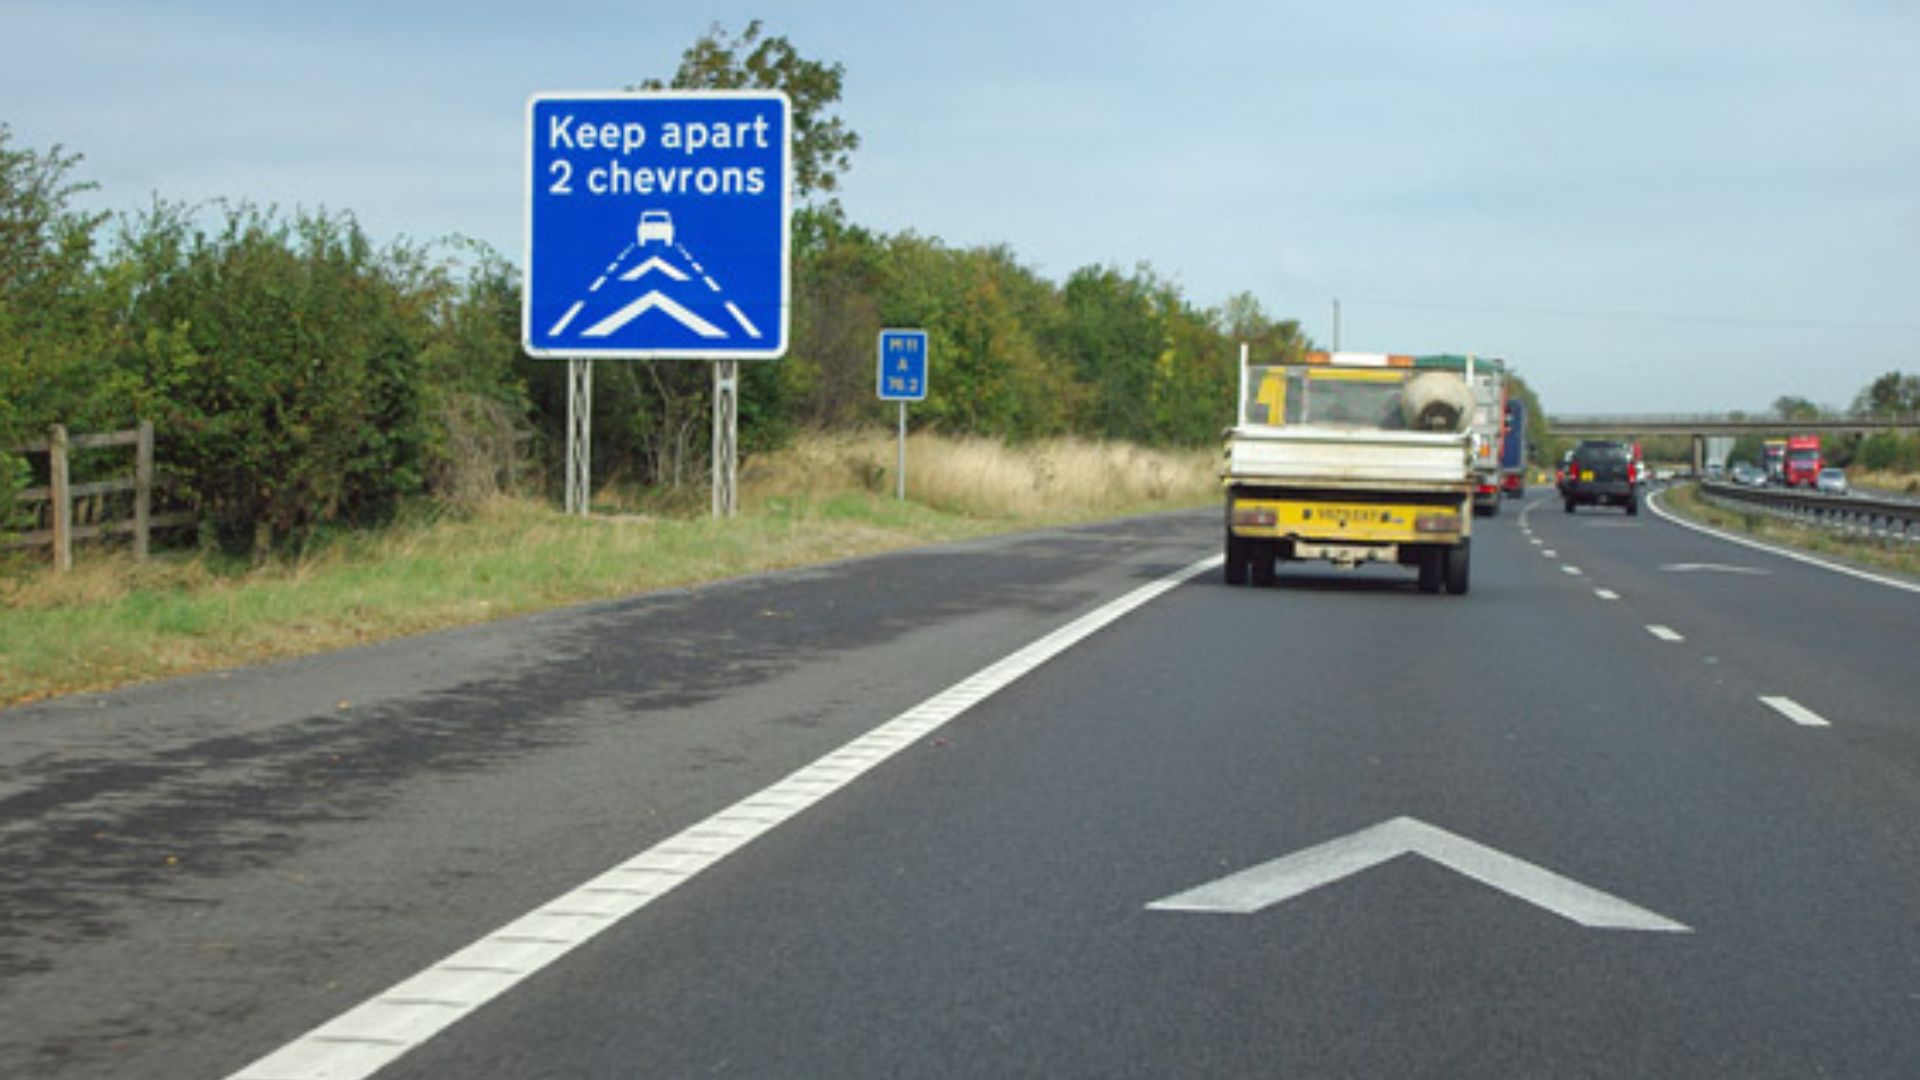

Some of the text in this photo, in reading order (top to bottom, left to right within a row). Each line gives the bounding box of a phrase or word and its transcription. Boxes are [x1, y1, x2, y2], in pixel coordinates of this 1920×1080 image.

[549, 114, 769, 155] Keep apart
[548, 159, 766, 194] 2 chevrons
